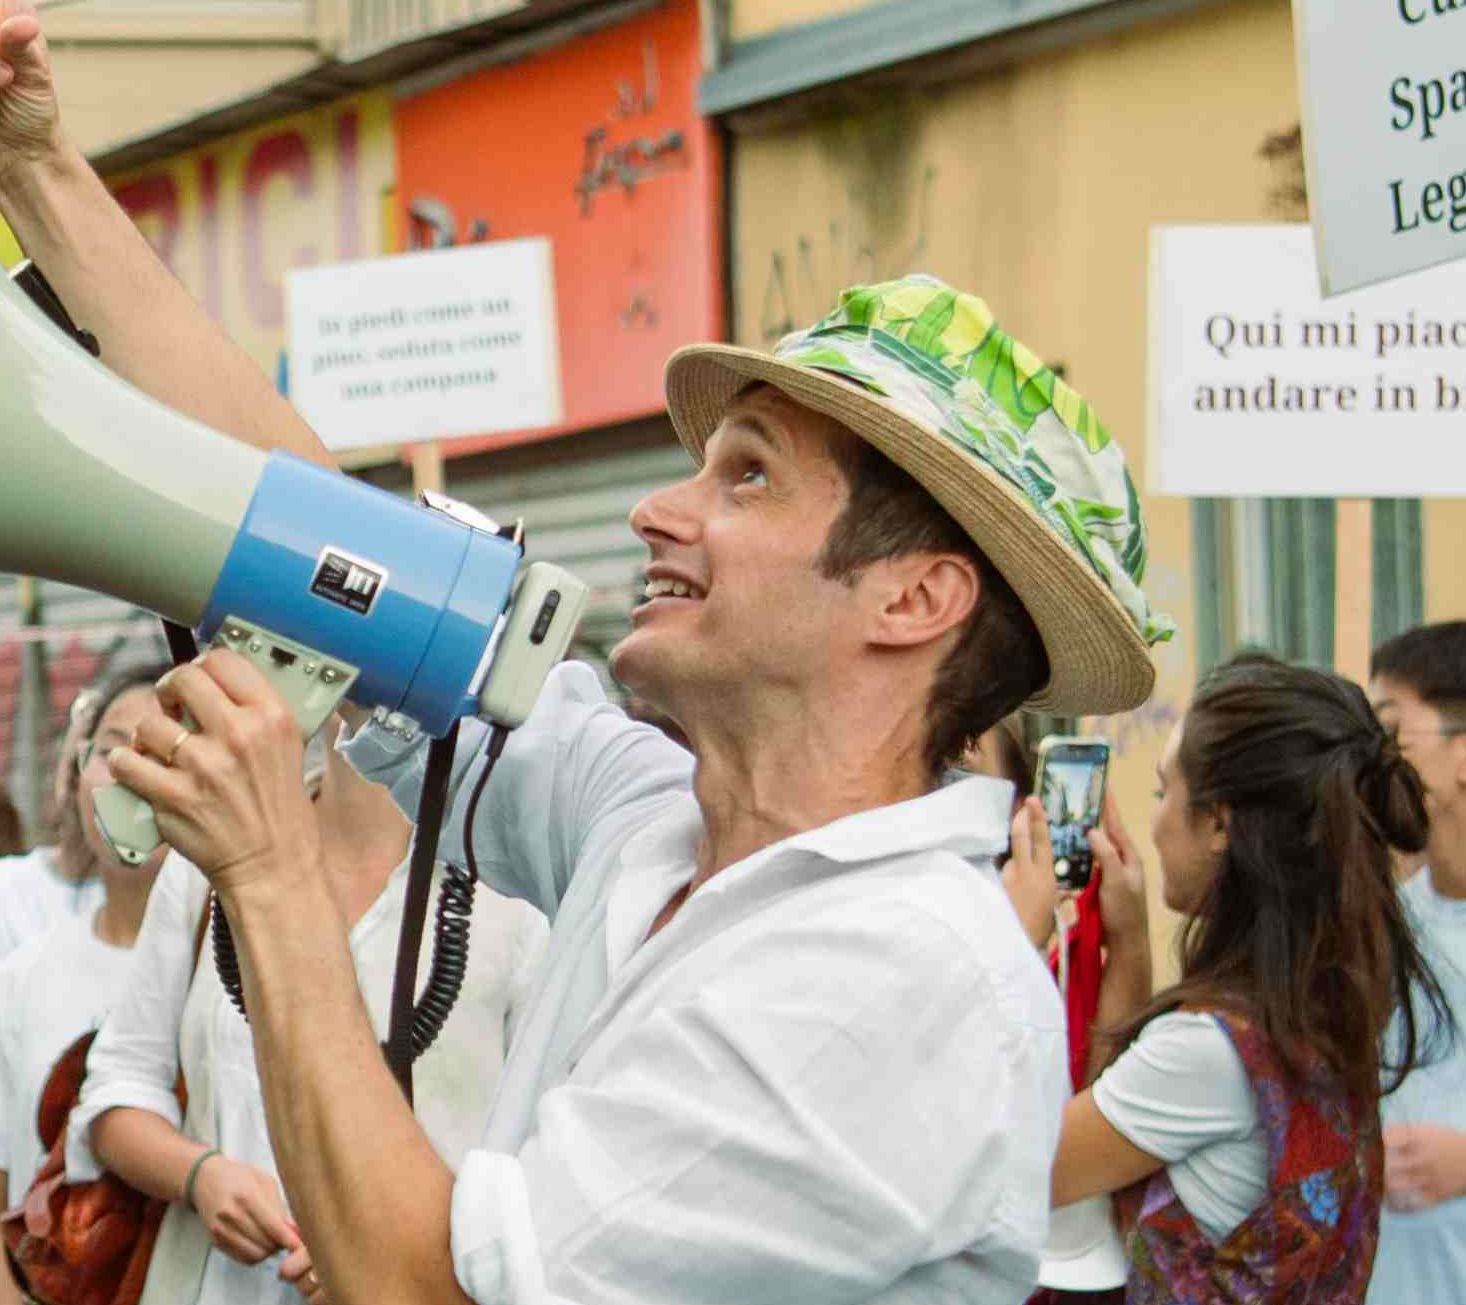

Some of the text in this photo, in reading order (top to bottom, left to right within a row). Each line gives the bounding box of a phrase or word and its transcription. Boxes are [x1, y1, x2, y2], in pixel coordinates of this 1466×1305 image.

[1205, 313, 1283, 358] Qui
[1301, 311, 1357, 348] mi
[1194, 376, 1358, 412] andare
[1375, 376, 1416, 411] in
